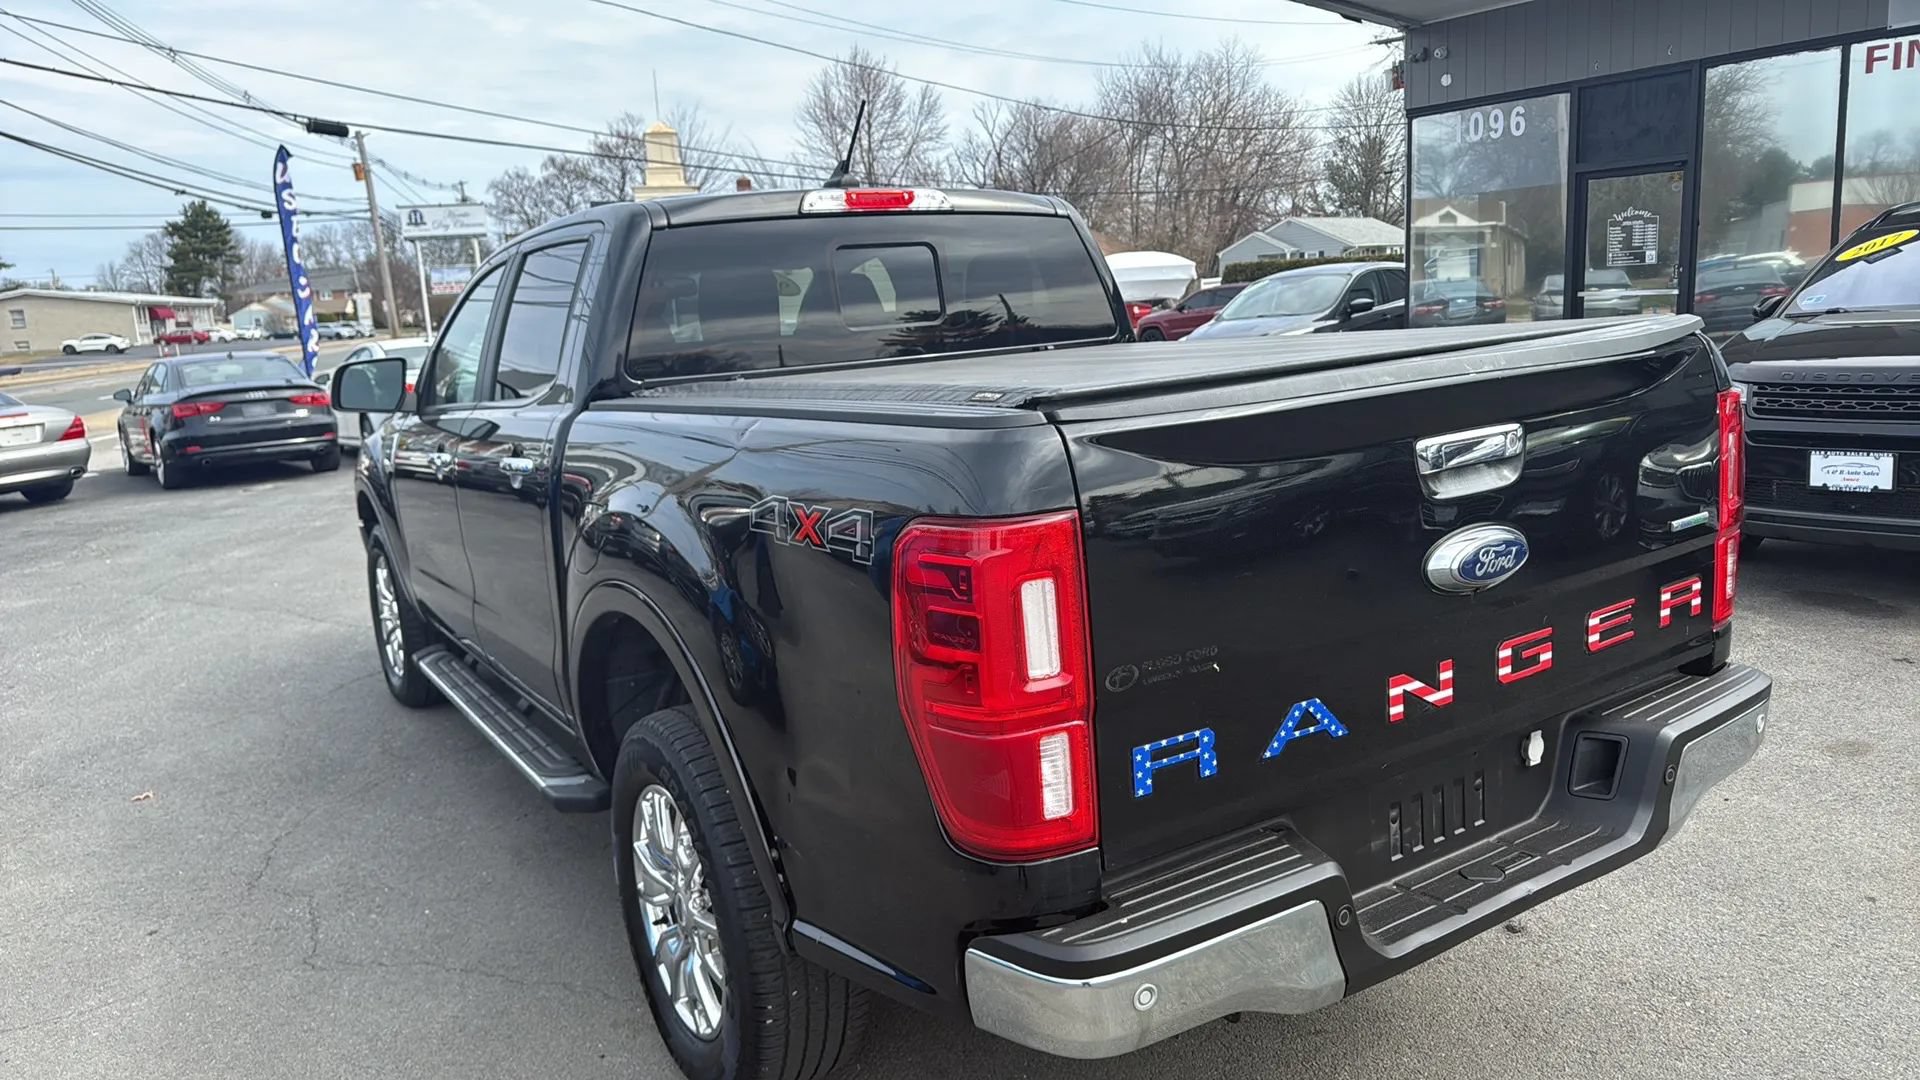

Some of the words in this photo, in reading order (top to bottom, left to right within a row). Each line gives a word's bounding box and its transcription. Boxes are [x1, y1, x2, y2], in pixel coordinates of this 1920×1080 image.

[1456, 105, 1526, 145] 1096
[1613, 206, 1652, 221] Welcome
[1851, 233, 1904, 256] 2017
[1475, 544, 1521, 577] Ford
[1132, 577, 1702, 797] RANGER
